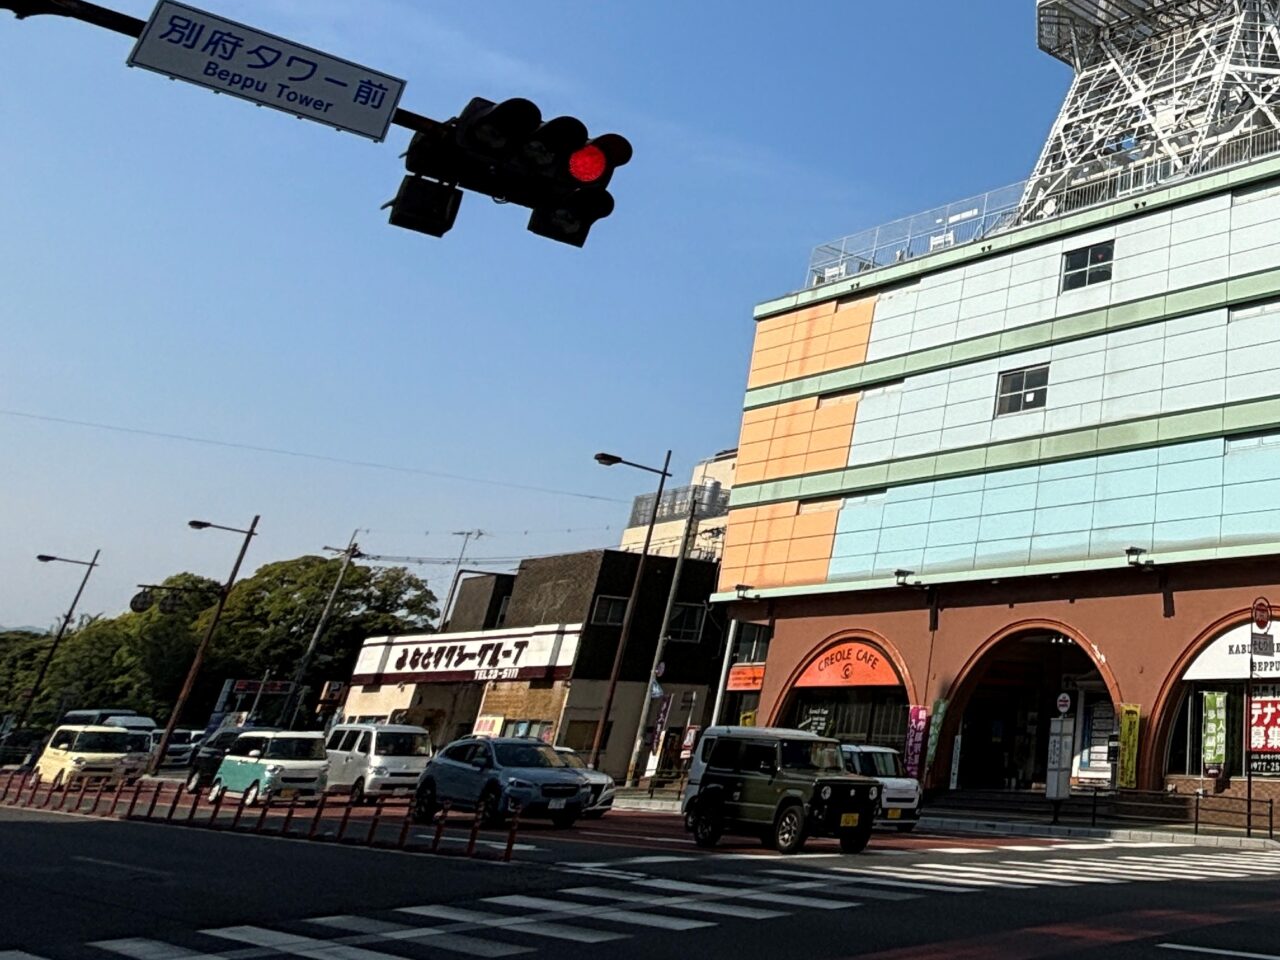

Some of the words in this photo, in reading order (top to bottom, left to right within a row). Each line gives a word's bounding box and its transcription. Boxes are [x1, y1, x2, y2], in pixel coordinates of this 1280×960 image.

[158, 14, 389, 110] 別府タワー前
[203, 60, 268, 93] Beppu
[276, 83, 334, 114] Tower
[818, 648, 853, 671] CREOLE
[856, 649, 880, 670] CAFE
[1251, 660, 1280, 672] BEPPU
